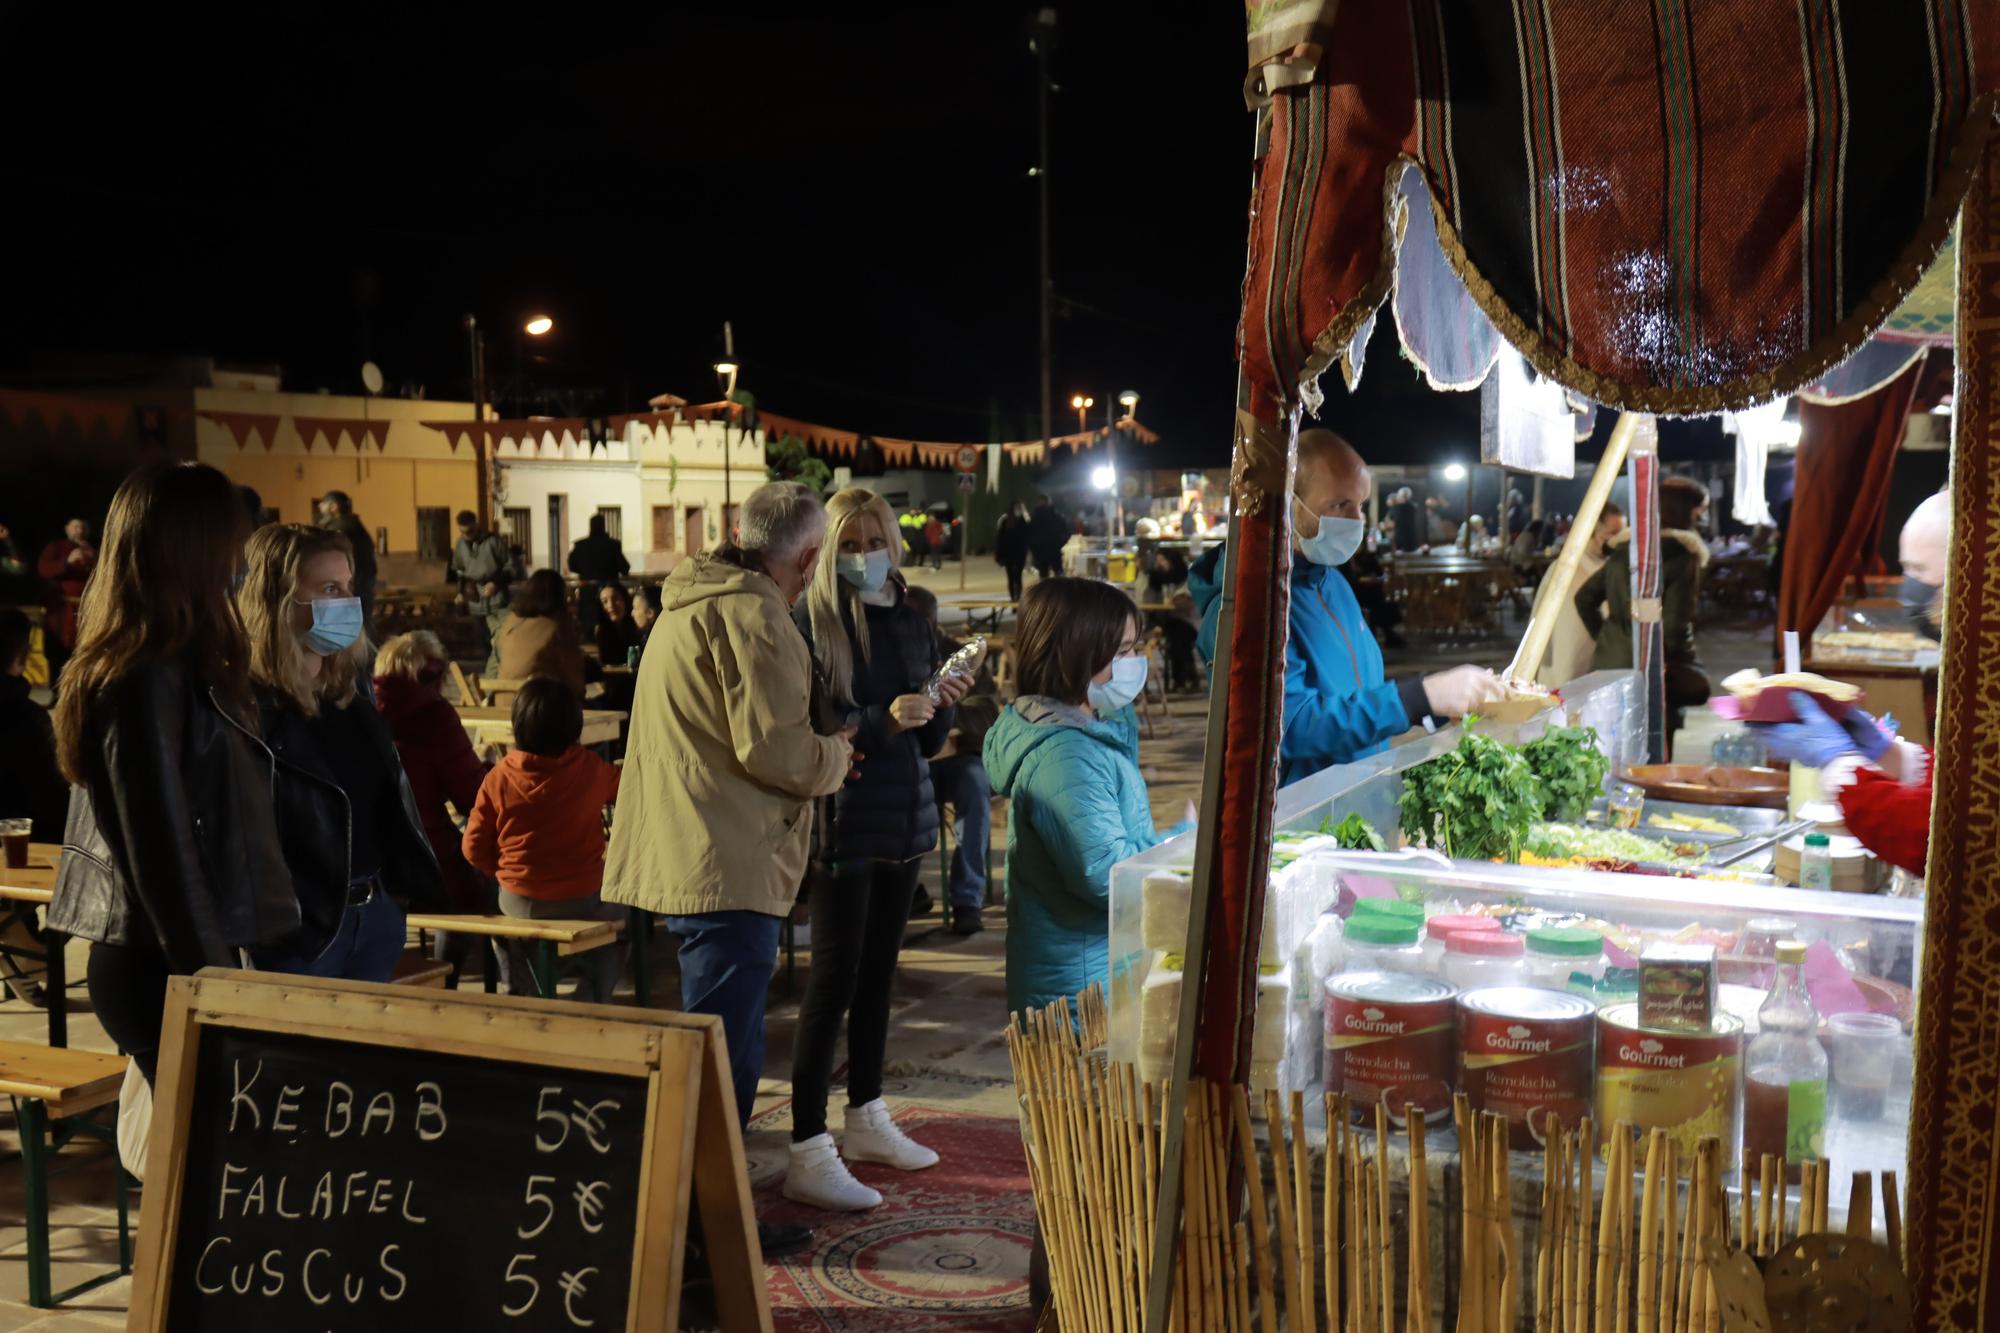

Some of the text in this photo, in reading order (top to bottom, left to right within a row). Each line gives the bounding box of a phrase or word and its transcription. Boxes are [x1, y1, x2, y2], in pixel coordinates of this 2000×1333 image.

[1344, 1014, 1405, 1034] Gourmet
[1486, 1032, 1551, 1053] Gourmet
[1344, 1051, 1411, 1071] Remolacha
[1619, 1045, 1685, 1068] Gourmet
[1486, 1071, 1557, 1089] Remolacha
[229, 1058, 448, 1142] KEBAB
[218, 1162, 427, 1224] FALAFEL
